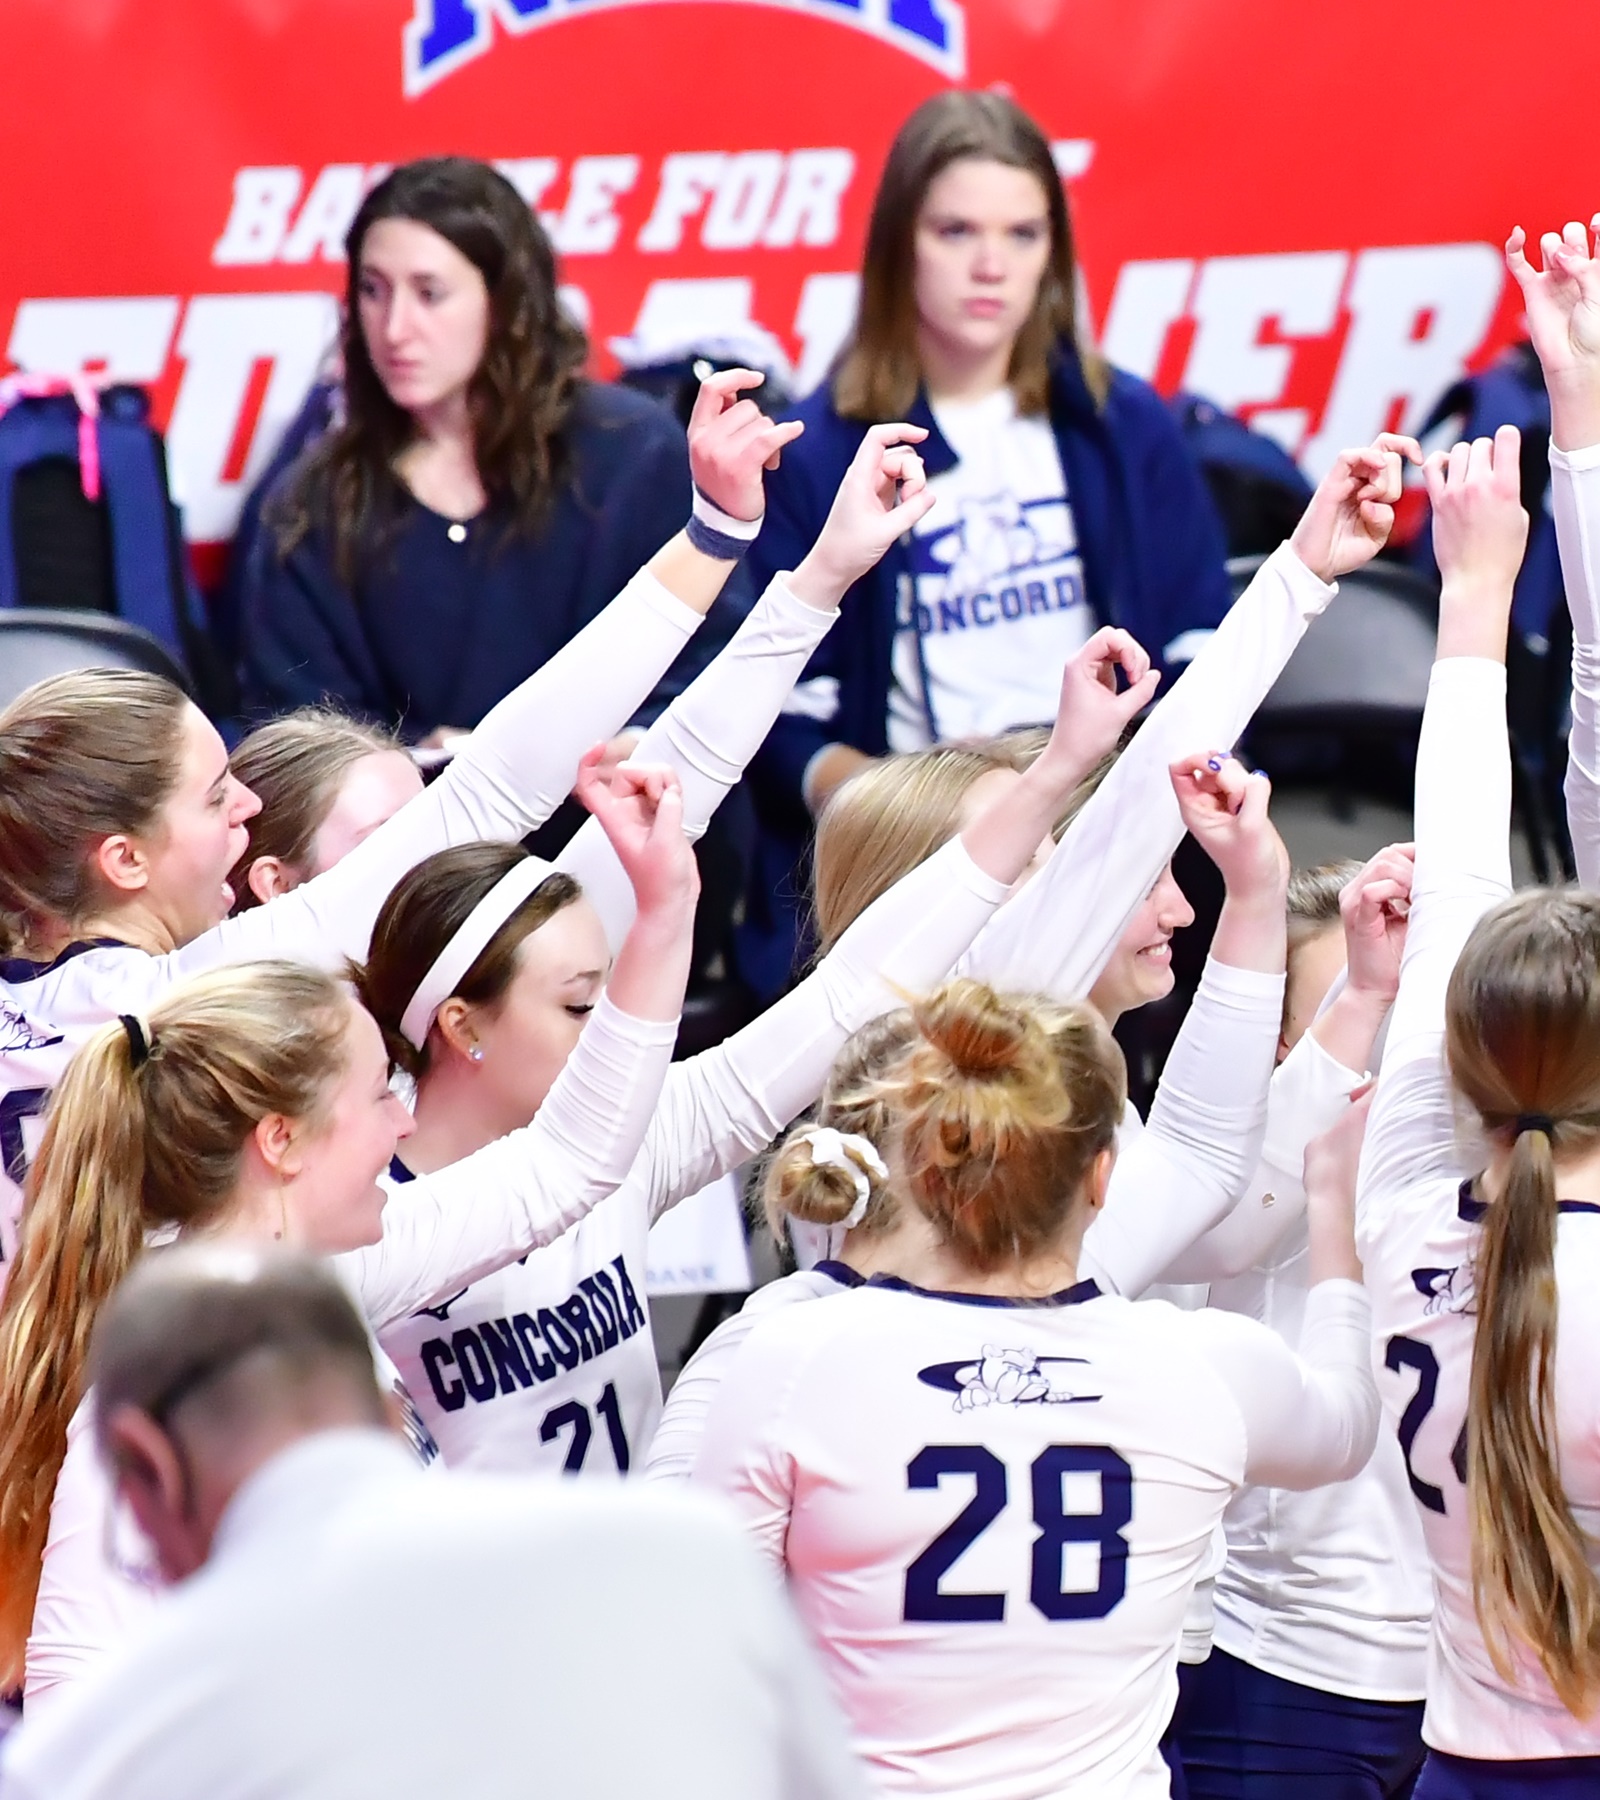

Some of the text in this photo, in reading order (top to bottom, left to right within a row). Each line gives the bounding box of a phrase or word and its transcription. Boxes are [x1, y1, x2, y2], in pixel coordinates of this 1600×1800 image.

[636, 147, 856, 254] FOR
[419, 1253, 647, 1414] CONCORDIA
[536, 1377, 631, 1482] 21
[901, 1441, 1134, 1624] 28
